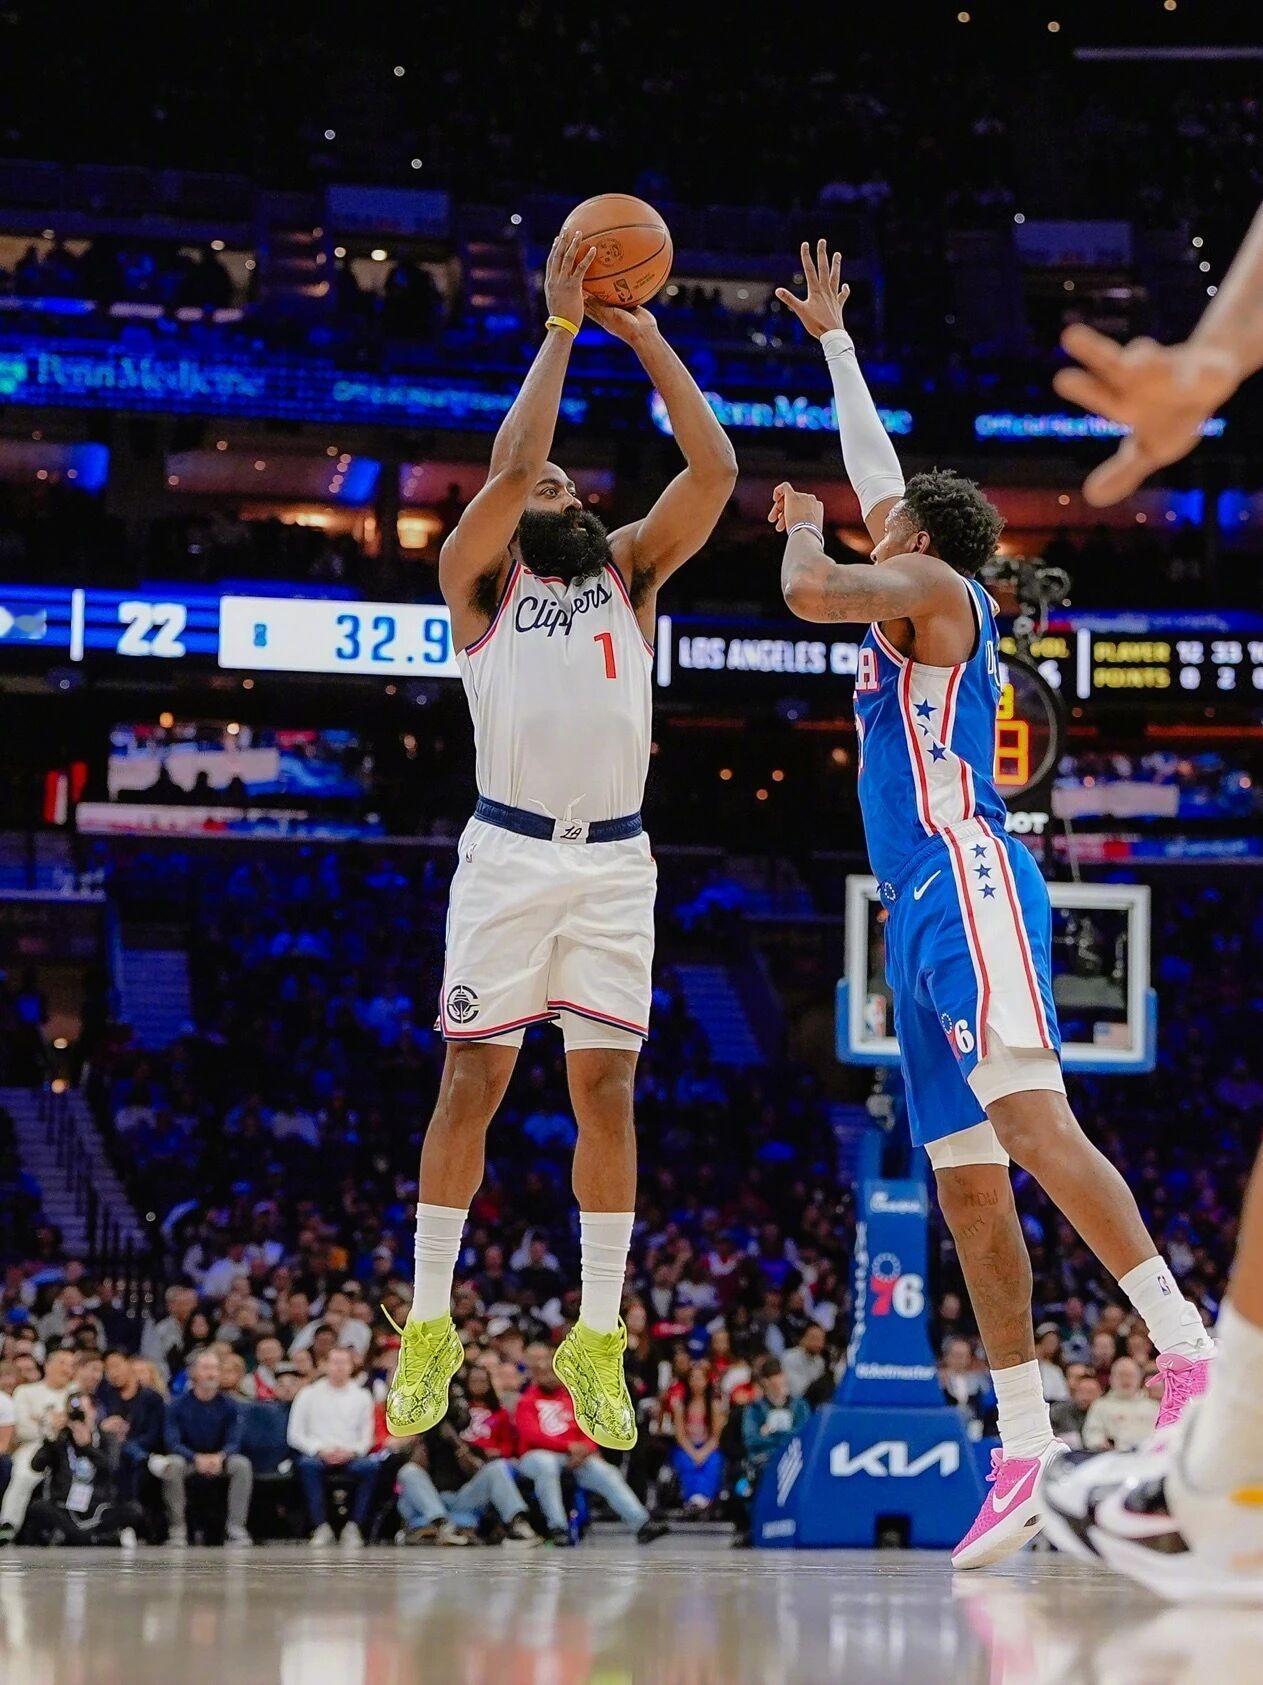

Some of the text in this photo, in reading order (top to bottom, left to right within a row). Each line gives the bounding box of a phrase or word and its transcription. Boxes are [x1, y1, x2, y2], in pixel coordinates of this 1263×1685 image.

[116, 601, 188, 657] 22
[335, 614, 448, 663] 32.9
[593, 632, 617, 679] 1
[679, 636, 726, 670] LOS
[726, 639, 827, 674] ANGELES
[869, 1273, 925, 1319] 76
